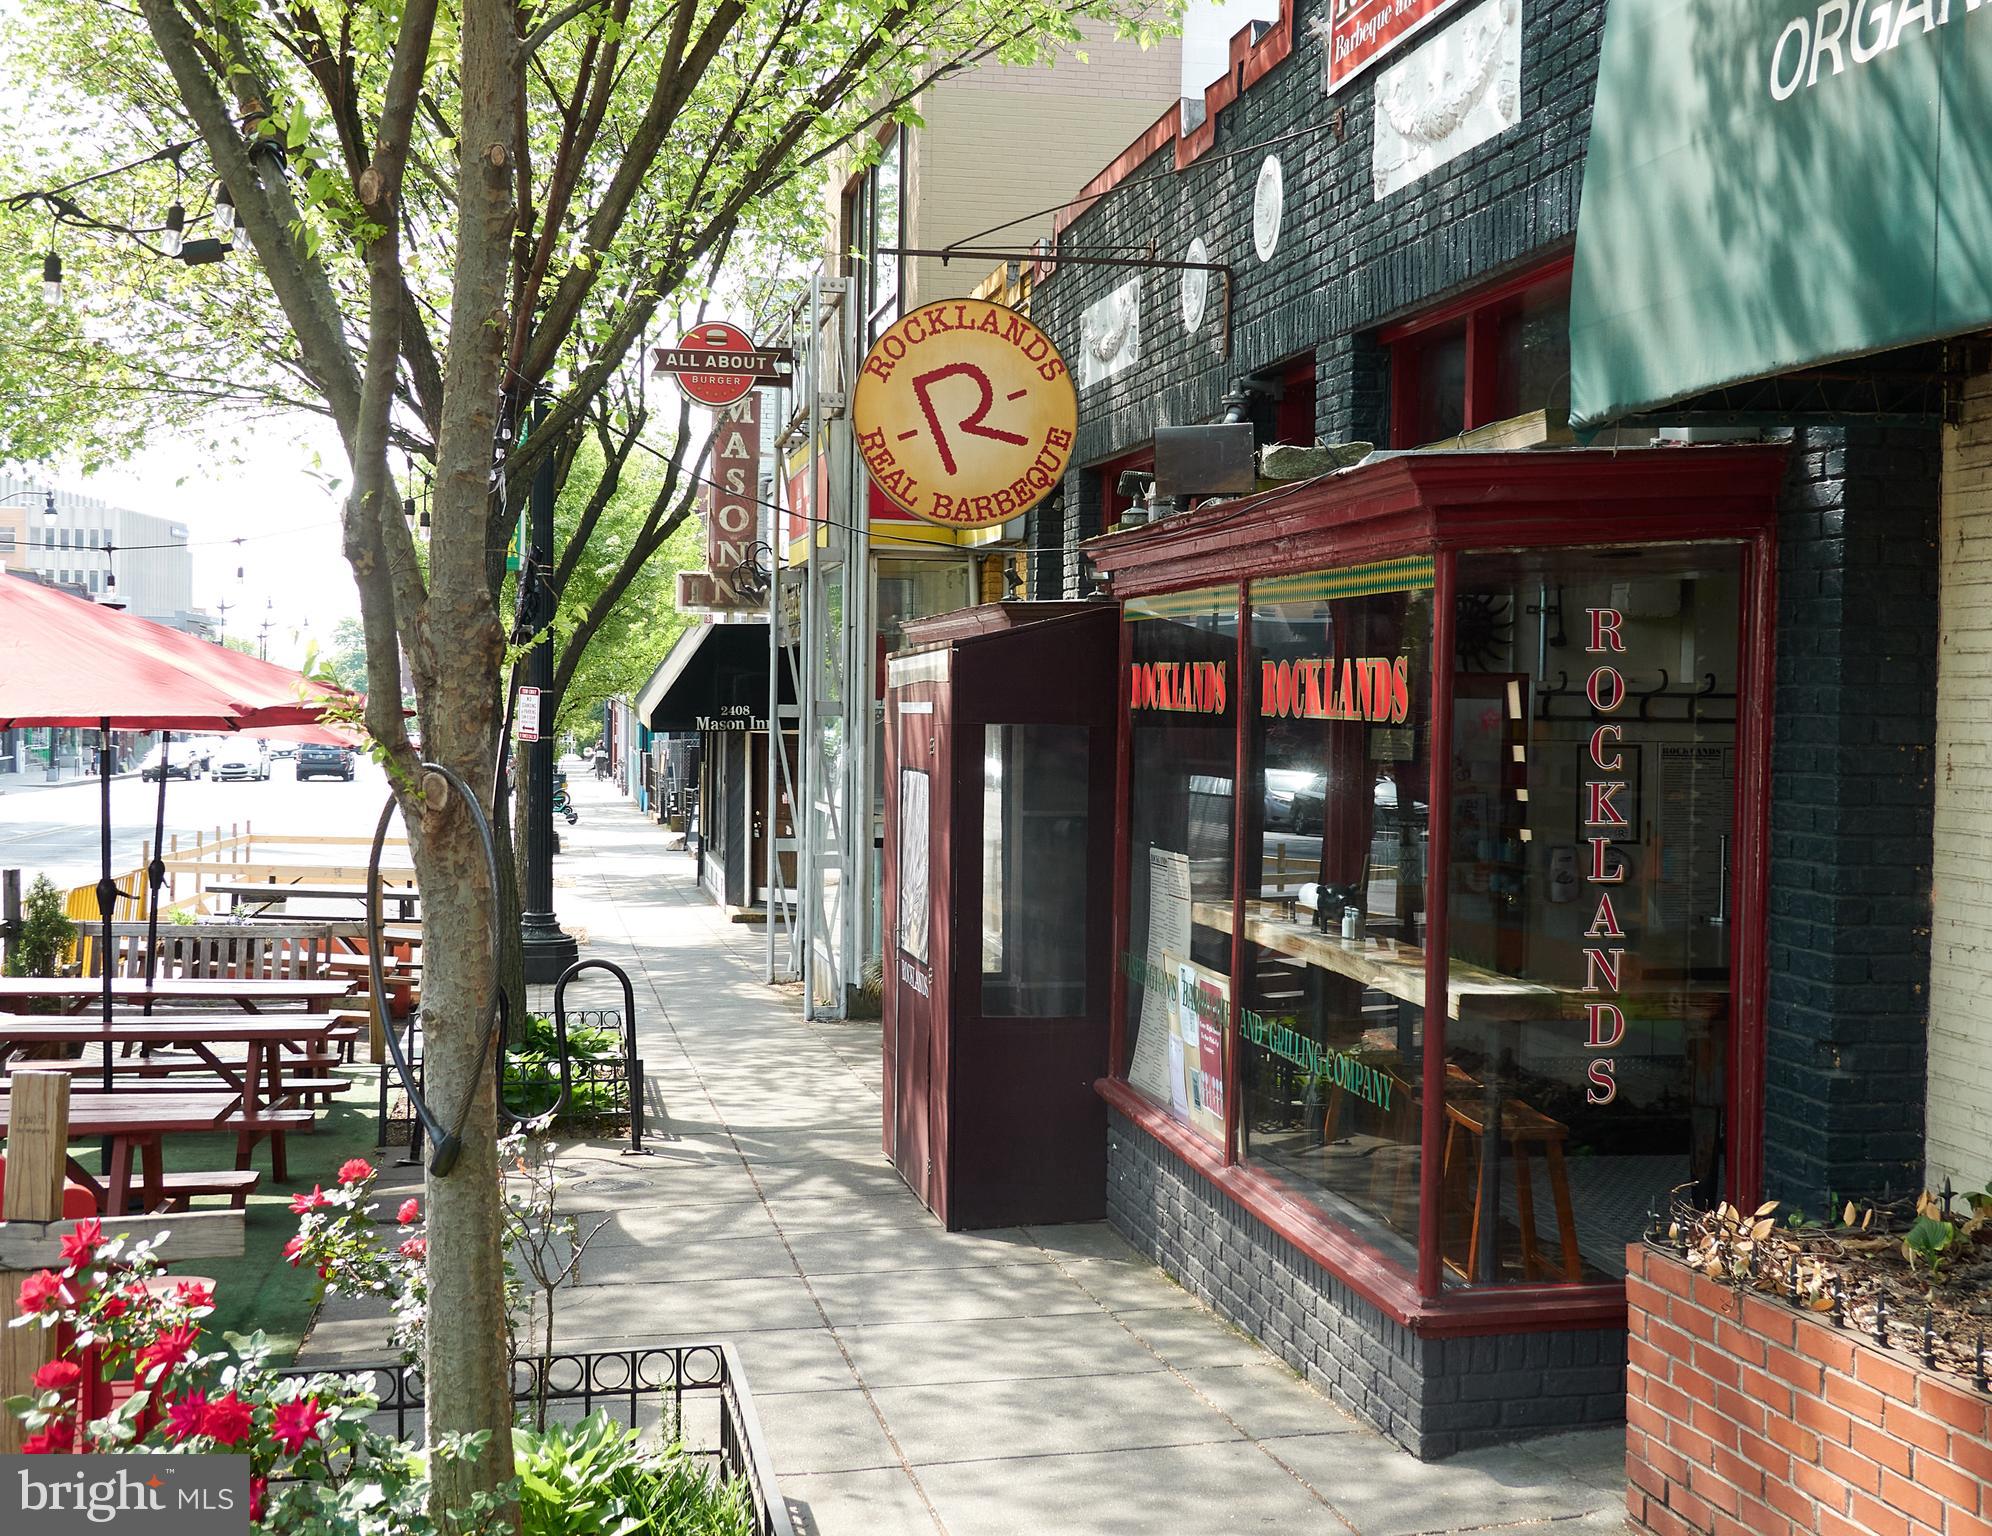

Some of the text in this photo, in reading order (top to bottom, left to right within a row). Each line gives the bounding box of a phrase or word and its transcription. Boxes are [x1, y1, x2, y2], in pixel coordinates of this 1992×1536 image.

[1335, 5, 1393, 64] Barbeque
[1395, 0, 1417, 16] an
[666, 353, 766, 370] ALL ABOUT
[865, 305, 1066, 383] ROCKLANDS
[691, 376, 741, 385] BURGER
[718, 397, 755, 567] MASON
[858, 426, 1073, 522] REAL BARBEQUE
[688, 577, 769, 605] IN
[721, 705, 751, 716] 2408
[1130, 660, 1227, 715] ROCKLANDS
[1261, 656, 1409, 724] ROCKLANDS
[695, 716, 746, 731] Mason
[1582, 608, 1627, 1106] ROCKLANDS
[1239, 1008, 1263, 1046] AND
[1269, 1021, 1323, 1076] GRILLING
[1326, 1048, 1394, 1111] COMPANY
